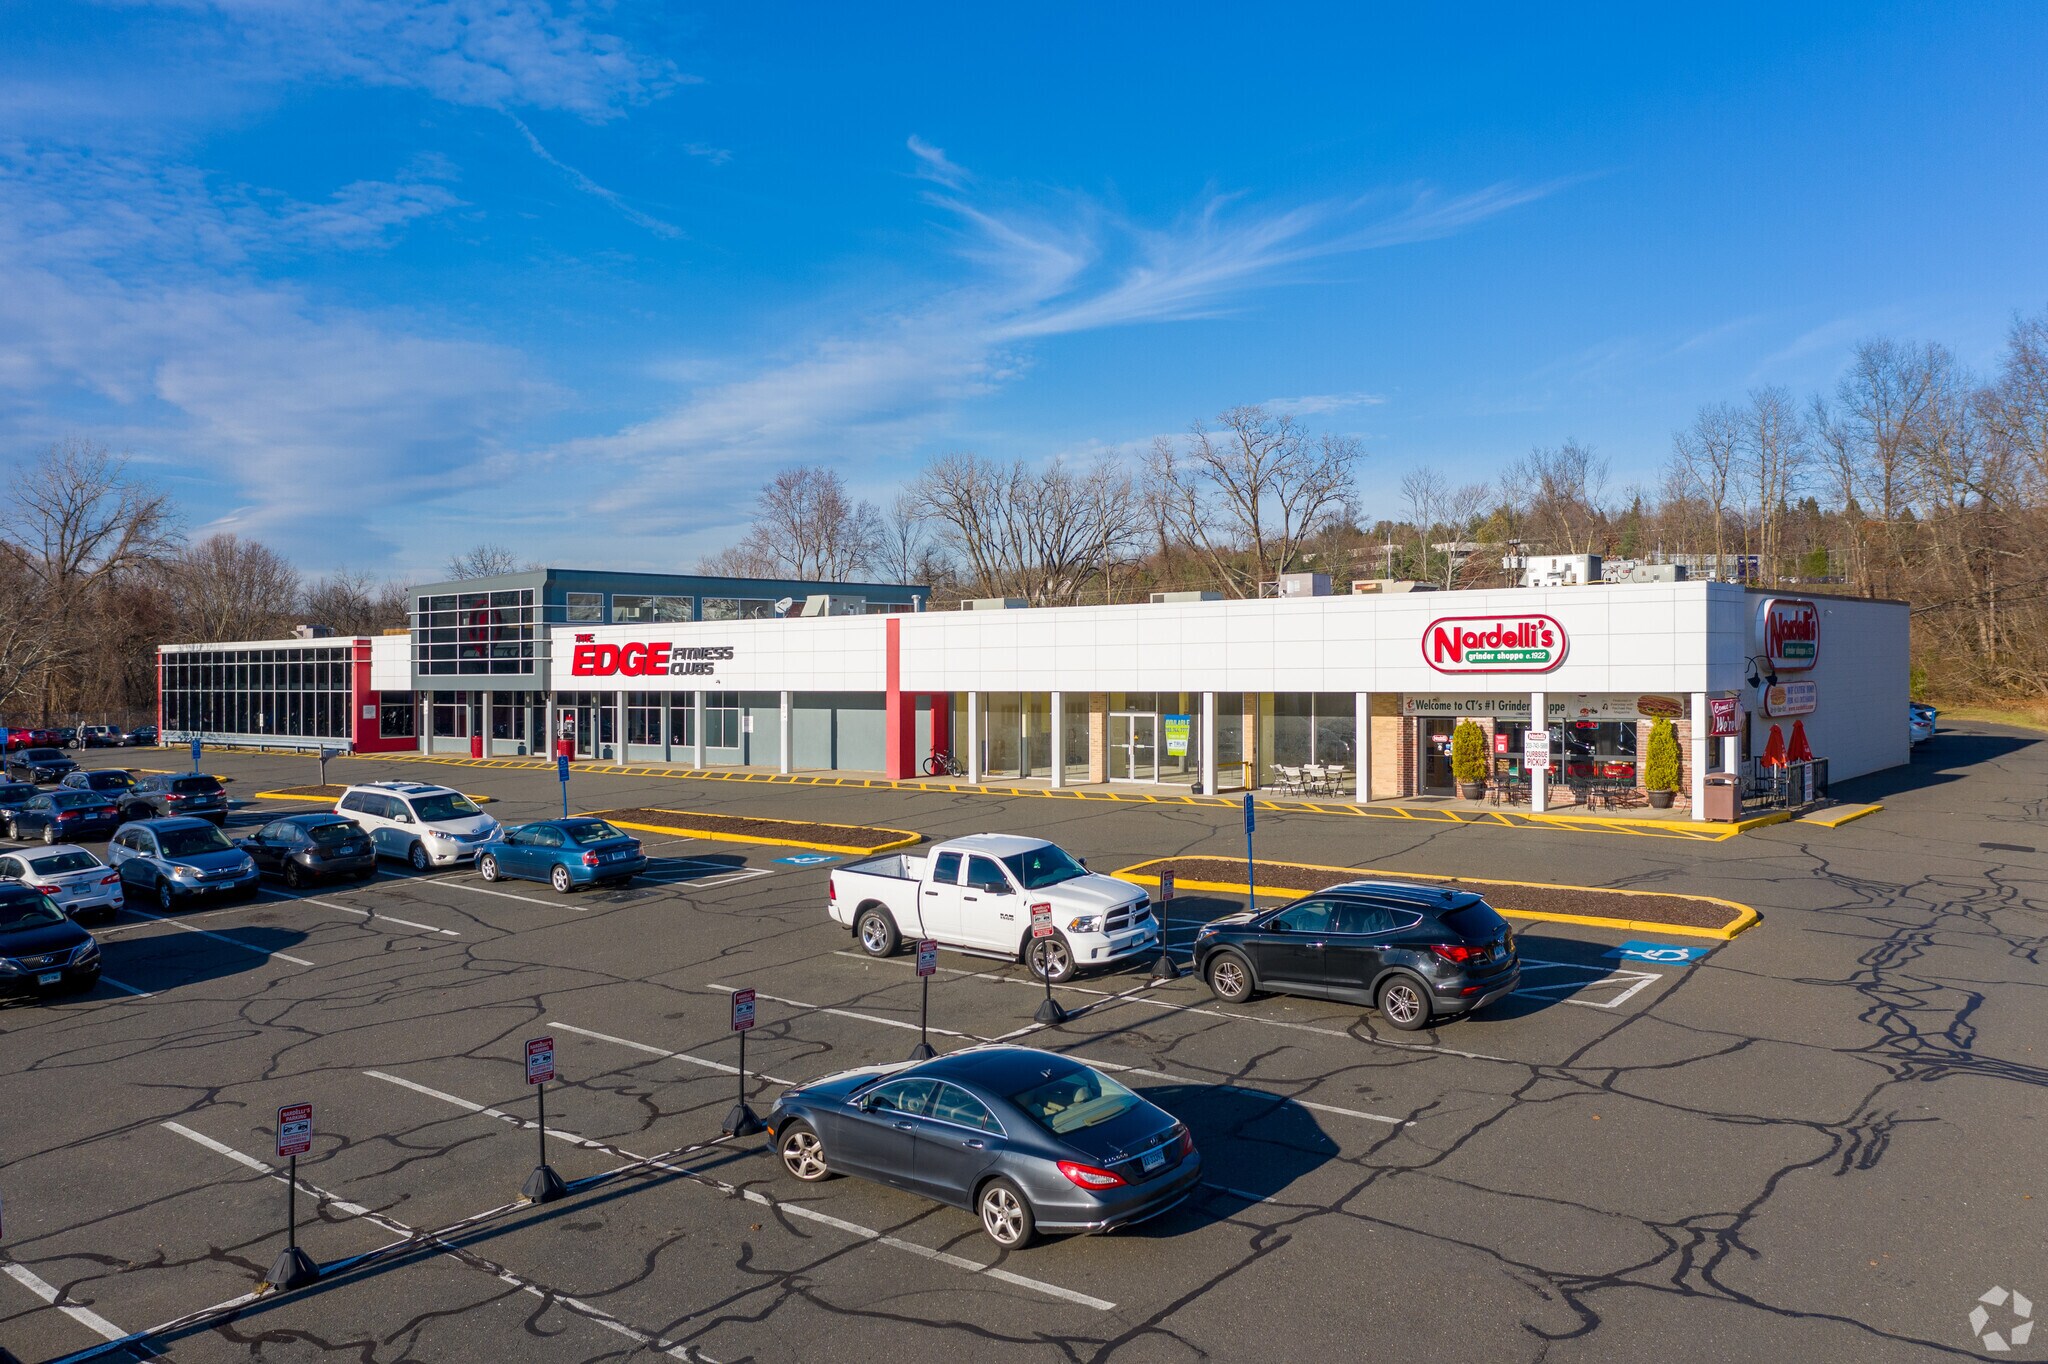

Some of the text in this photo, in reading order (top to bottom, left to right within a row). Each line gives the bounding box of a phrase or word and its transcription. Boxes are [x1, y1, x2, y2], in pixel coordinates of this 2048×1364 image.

[575, 633, 595, 643] THE
[1434, 619, 1555, 663] Nardelli's
[572, 642, 673, 677] EDGE
[672, 646, 734, 661] FITNESS
[1468, 651, 1494, 662] grinder
[1497, 651, 1524, 662] shoppe
[670, 662, 715, 675] CLUBS
[1416, 699, 1451, 711] Welcome
[1454, 700, 1463, 711] to
[1465, 699, 1482, 711] CT's
[1485, 700, 1495, 711] #1
[1498, 699, 1531, 711] Grinder
[1714, 702, 1729, 714] Come
[1575, 721, 1598, 729] OPEN
[1716, 716, 1735, 733] We're
[1527, 758, 1547, 767] PICKUP
[282, 1107, 310, 1117] NARDELLI'S
[285, 1114, 307, 1122] PARKING
